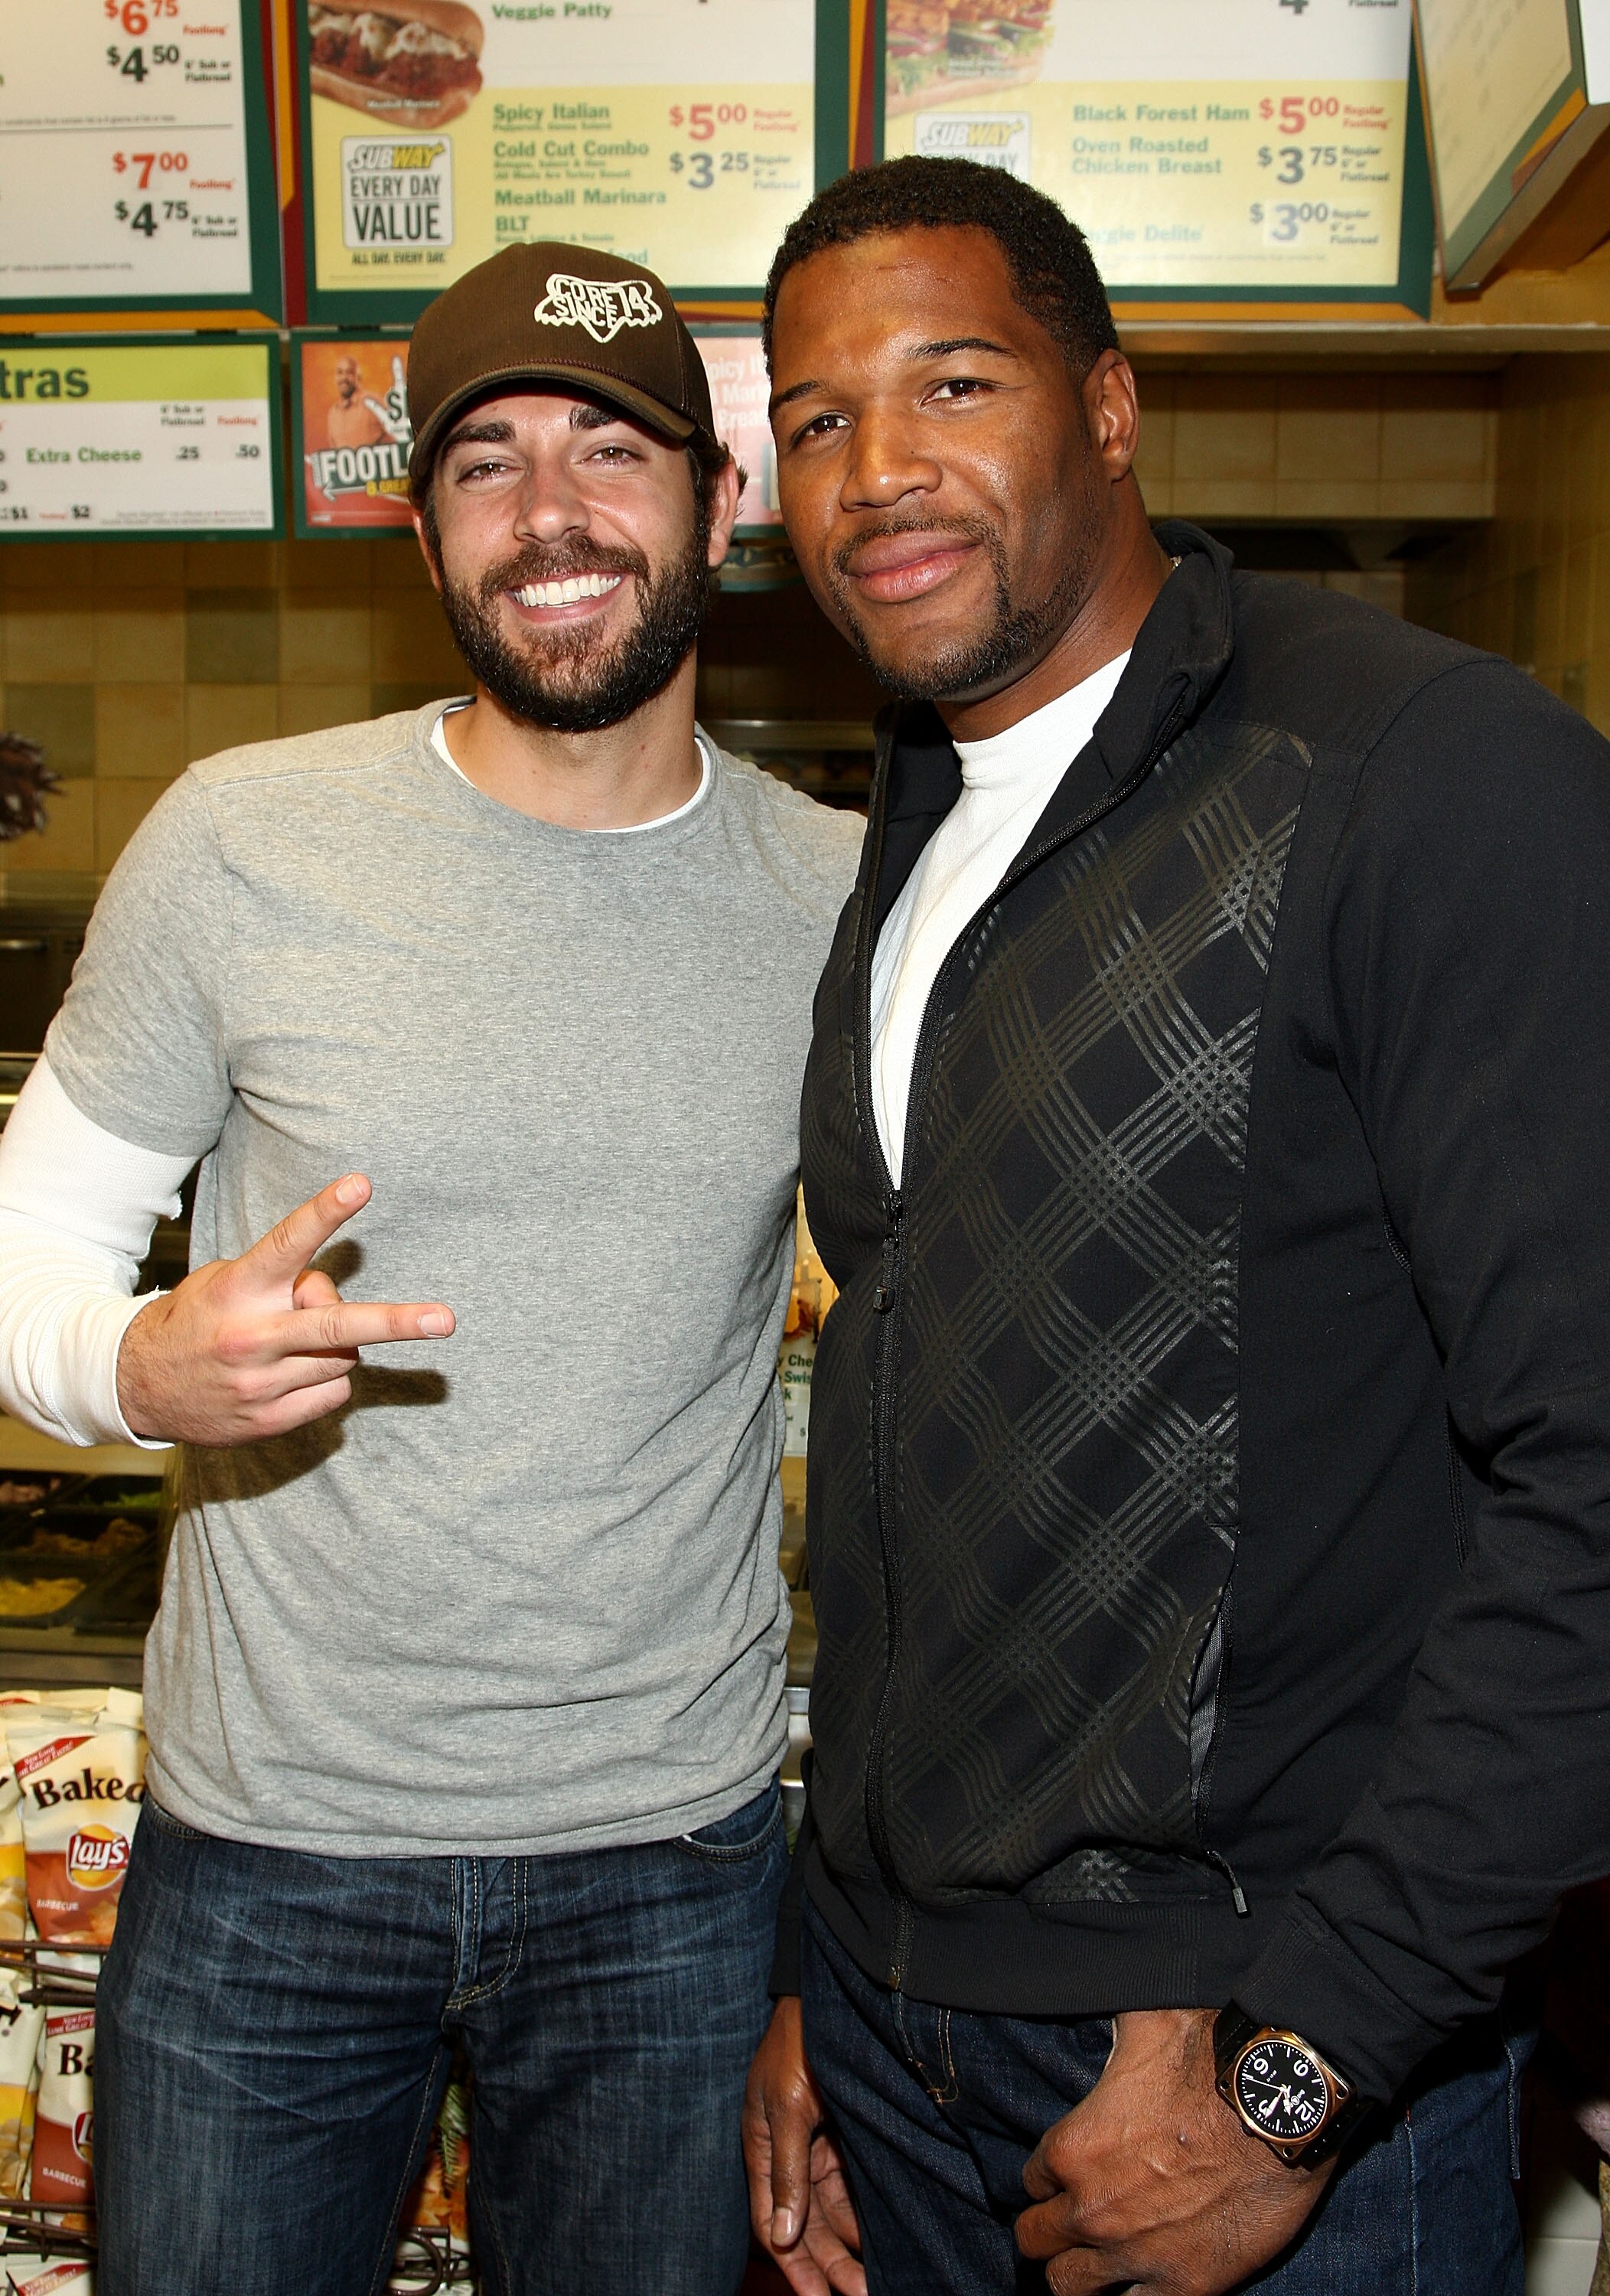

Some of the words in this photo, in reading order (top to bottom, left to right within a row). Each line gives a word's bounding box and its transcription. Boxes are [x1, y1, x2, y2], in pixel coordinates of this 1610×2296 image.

[493, 3, 555, 21] Veggie
[563, 2, 612, 18] Patty
[494, 103, 544, 122] Spicy
[552, 102, 610, 119] Italian
[1073, 105, 1127, 122] Black
[1136, 105, 1199, 122] Forest
[1207, 104, 1250, 121] Ham
[921, 119, 1024, 149] SUBWAY
[494, 140, 536, 158] Cold
[544, 139, 574, 157] Cut
[584, 139, 649, 157] Combo
[1073, 137, 1120, 154] Oven
[1129, 135, 1208, 153] Roasted
[347, 142, 445, 172] SUBWAY
[1072, 158, 1149, 174] Chicken
[1159, 158, 1222, 174] Breast
[350, 175, 403, 198] EVERY
[409, 174, 442, 196] DAY
[495, 188, 575, 205] Meatball
[584, 187, 666, 204] Marinara
[353, 203, 442, 240] VALUE
[495, 215, 530, 231] BLT
[0, 360, 90, 399] tras
[26, 447, 71, 464] Extra
[77, 445, 142, 462] Cheese
[235, 446, 259, 458] .50
[318, 442, 413, 484] FOOTL
[788, 1354, 813, 1368] Che
[784, 1371, 811, 1384] Swis
[42, 2166, 87, 2190] BARBECUE
